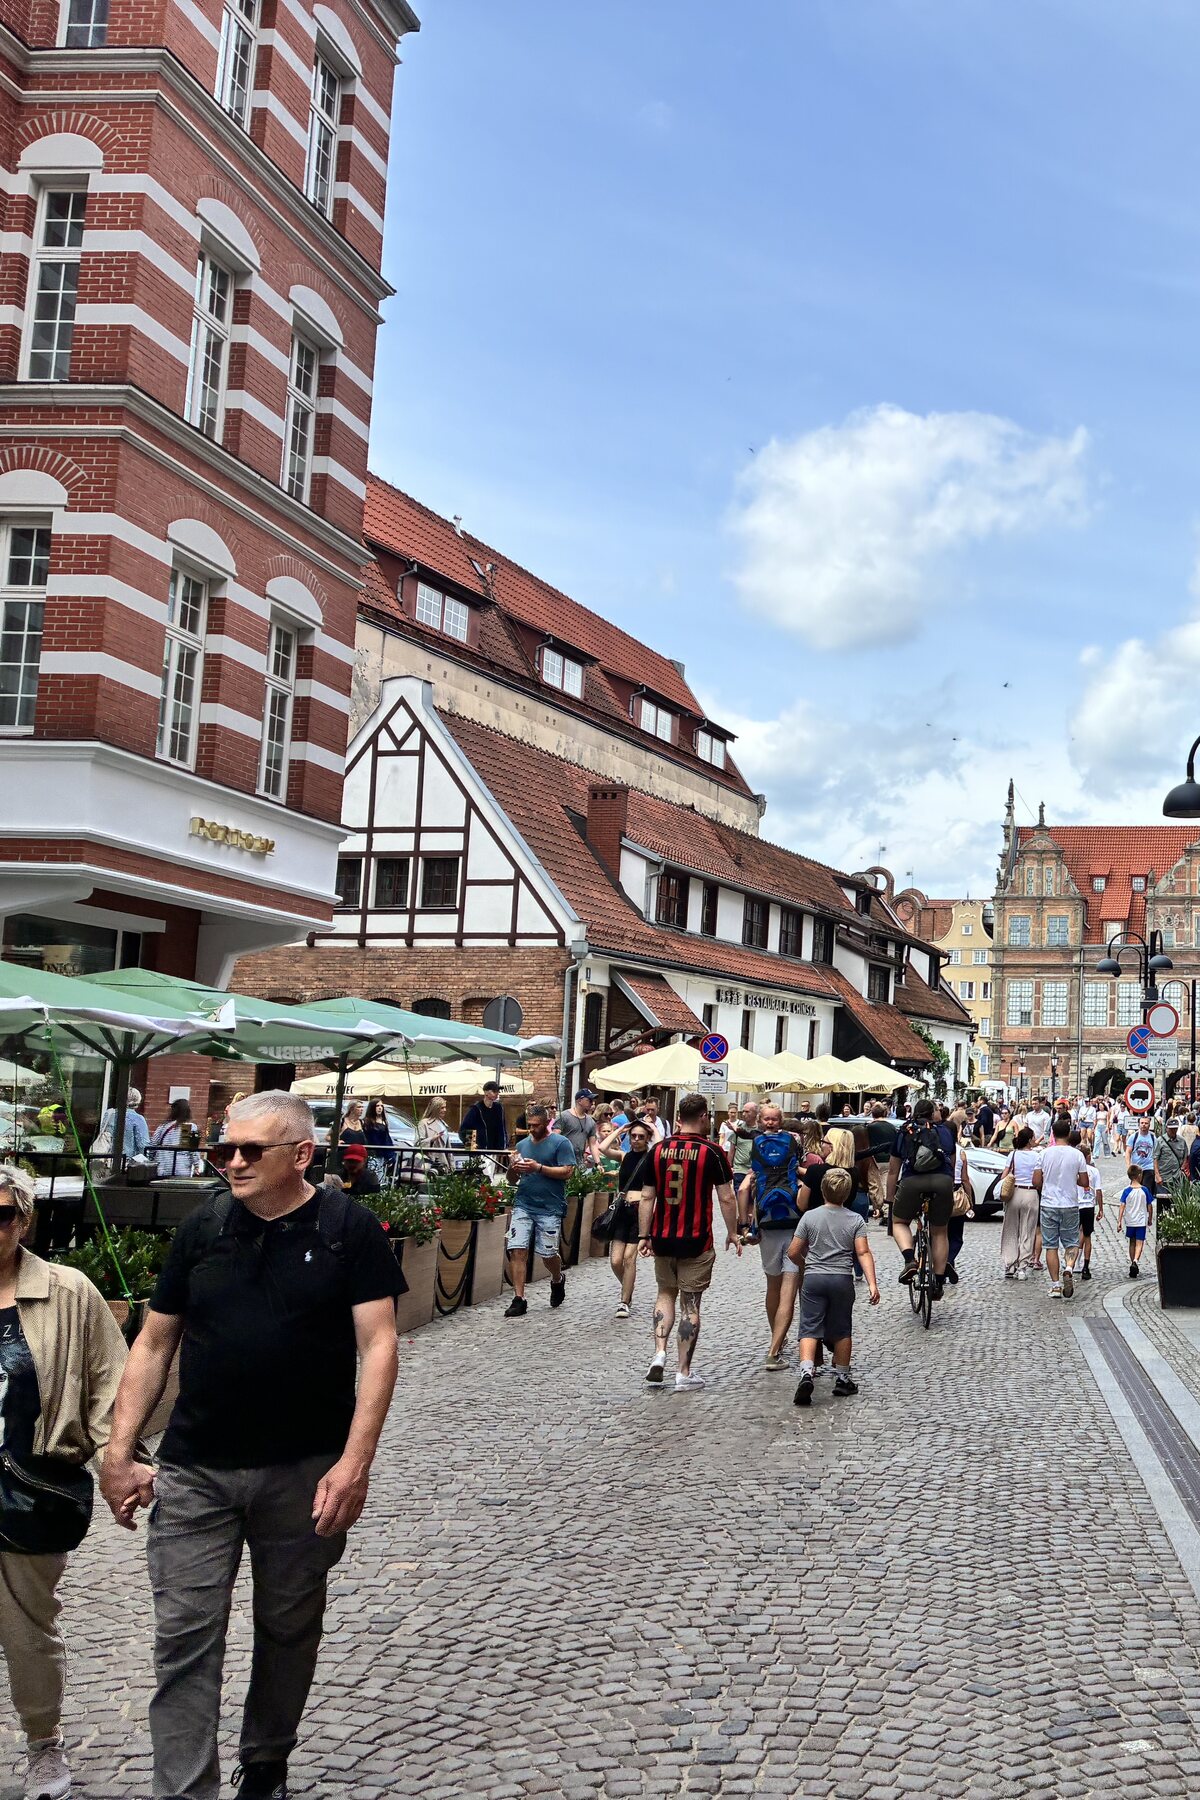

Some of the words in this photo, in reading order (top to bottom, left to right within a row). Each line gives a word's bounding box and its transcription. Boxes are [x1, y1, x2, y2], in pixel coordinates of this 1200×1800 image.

[326, 1084, 354, 1095] ŻYIEC
[418, 1084, 447, 1095] ŻYWIEC
[660, 1149, 698, 1161] MALDINI
[665, 1163, 684, 1206] 3
